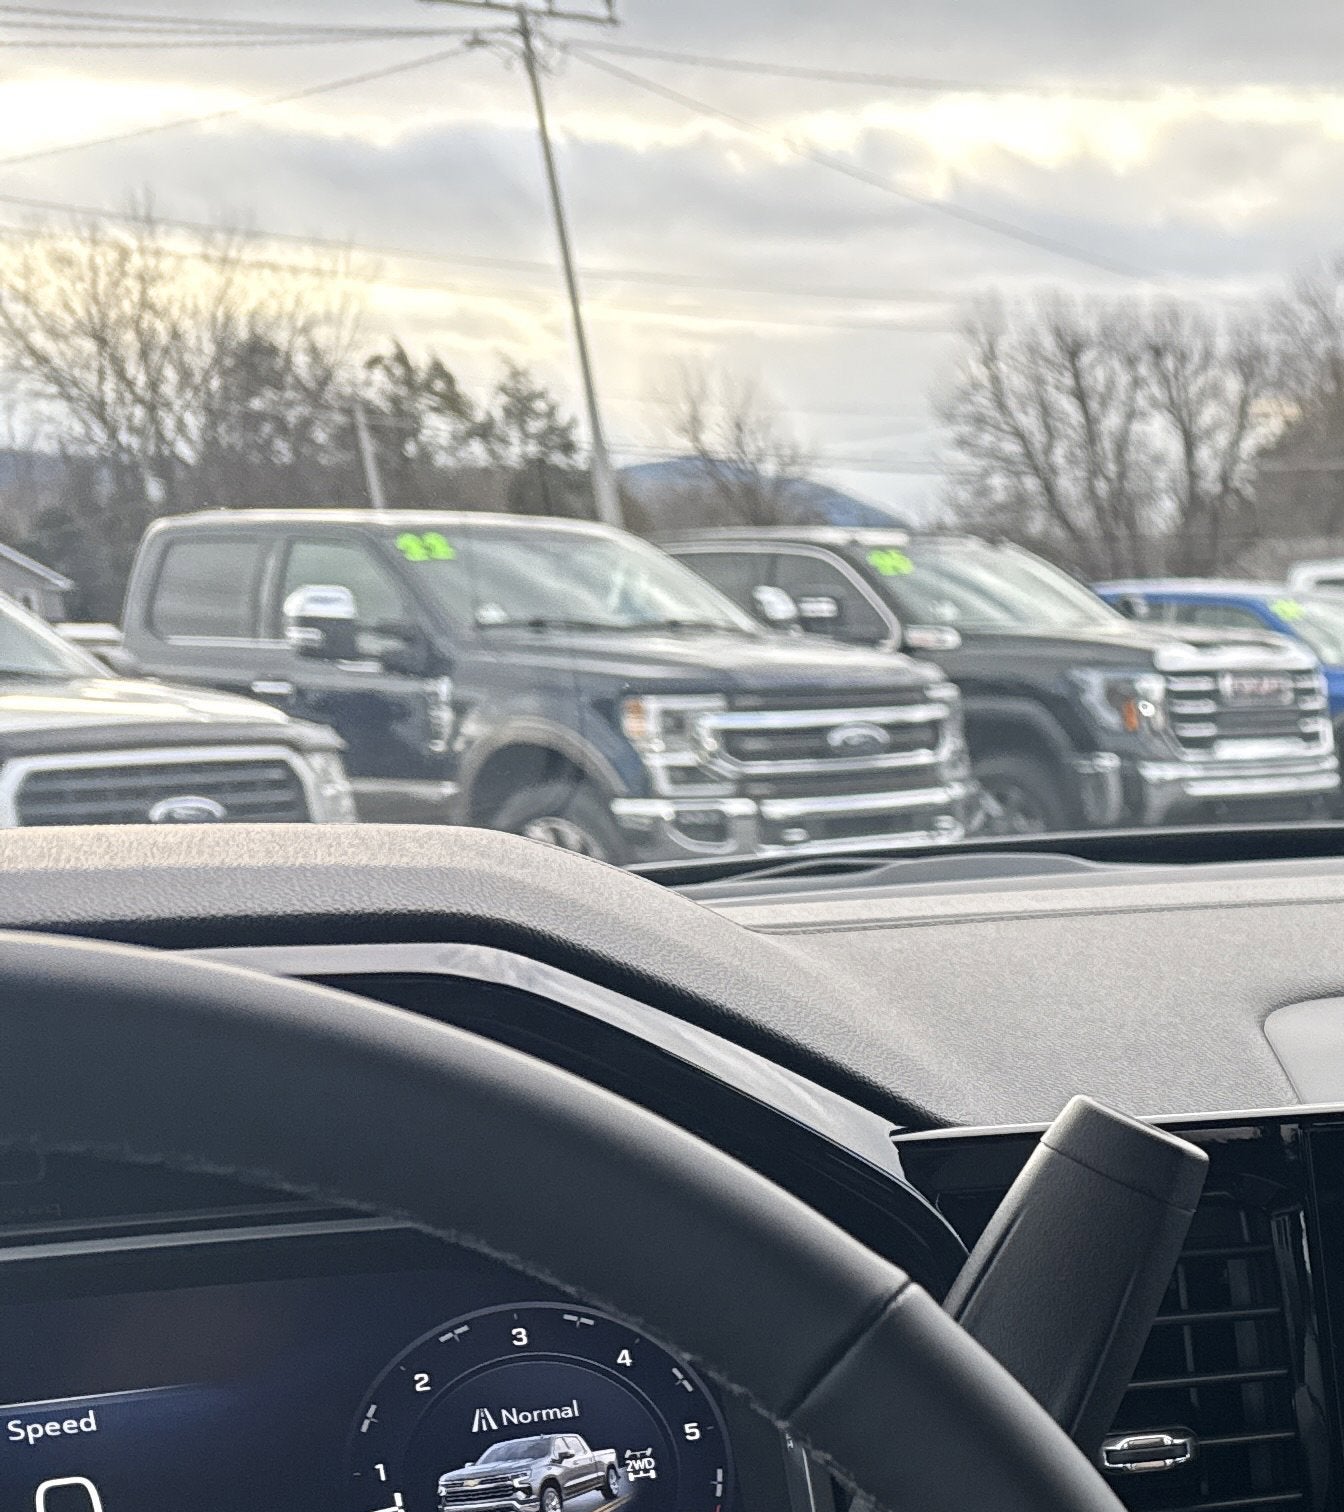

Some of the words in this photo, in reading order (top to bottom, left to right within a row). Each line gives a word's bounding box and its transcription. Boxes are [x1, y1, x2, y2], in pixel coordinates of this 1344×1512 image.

[512, 1328, 528, 1346] 3
[617, 1349, 632, 1367] 4
[414, 1373, 431, 1392] 2
[501, 1400, 579, 1426] Normal
[7, 1410, 97, 1445] Speed
[684, 1423, 700, 1440] 5
[374, 1463, 386, 1481] 1
[626, 1457, 655, 1472] 2WD
